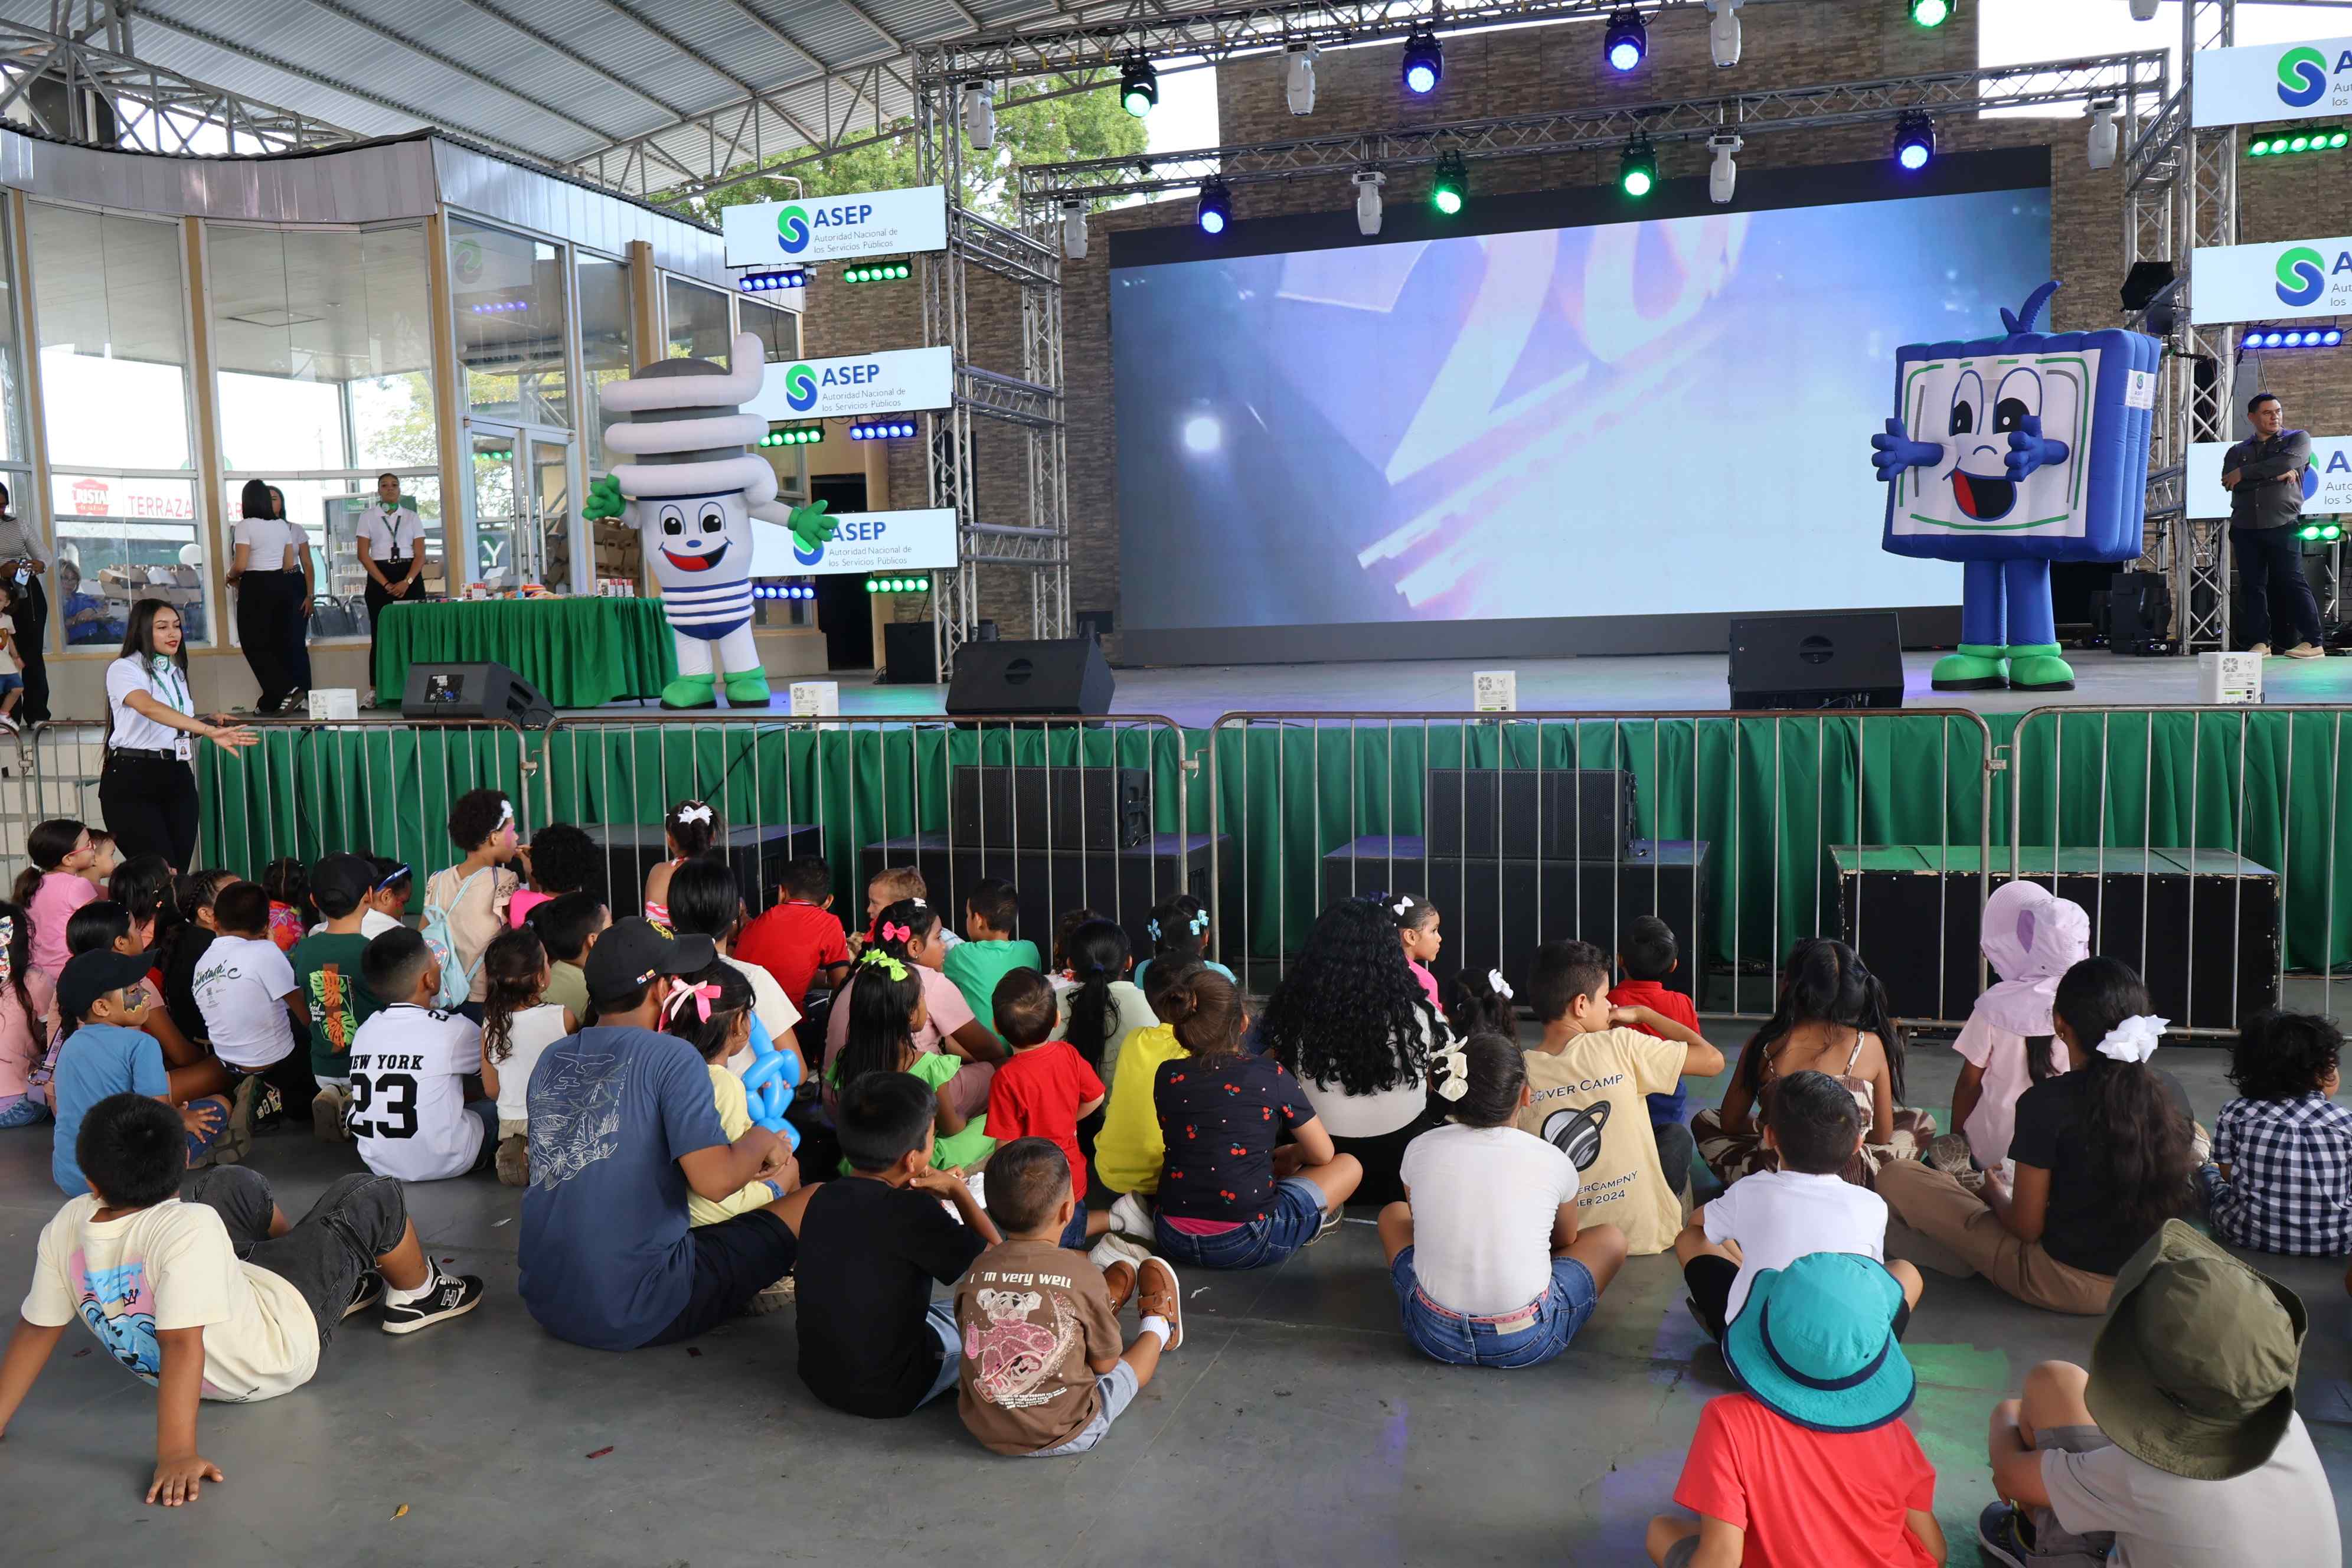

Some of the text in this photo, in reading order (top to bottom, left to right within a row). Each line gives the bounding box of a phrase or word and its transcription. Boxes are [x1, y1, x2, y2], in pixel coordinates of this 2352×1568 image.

[2333, 97, 2348, 106] los
[814, 204, 873, 228] ASEP
[814, 227, 898, 243] Autoridad Nacional de
[814, 239, 893, 253] los Servicios Públicos
[2330, 297, 2346, 306] los
[821, 364, 880, 387] ASEP
[822, 390, 860, 401] Autoridad
[862, 388, 894, 397] Nacional
[822, 398, 901, 411] los Servicios Públicos
[128, 495, 194, 517] TERRAZA
[2324, 495, 2340, 504] los
[829, 544, 912, 556] Autoridad Nacional de
[829, 555, 907, 567] los Servicios Públicos
[377, 1054, 424, 1070] YORK
[347, 1073, 419, 1139] 23
[1596, 1190, 1625, 1204] 2024
[1002, 1272, 1034, 1286] very
[1039, 1273, 1072, 1288] well
